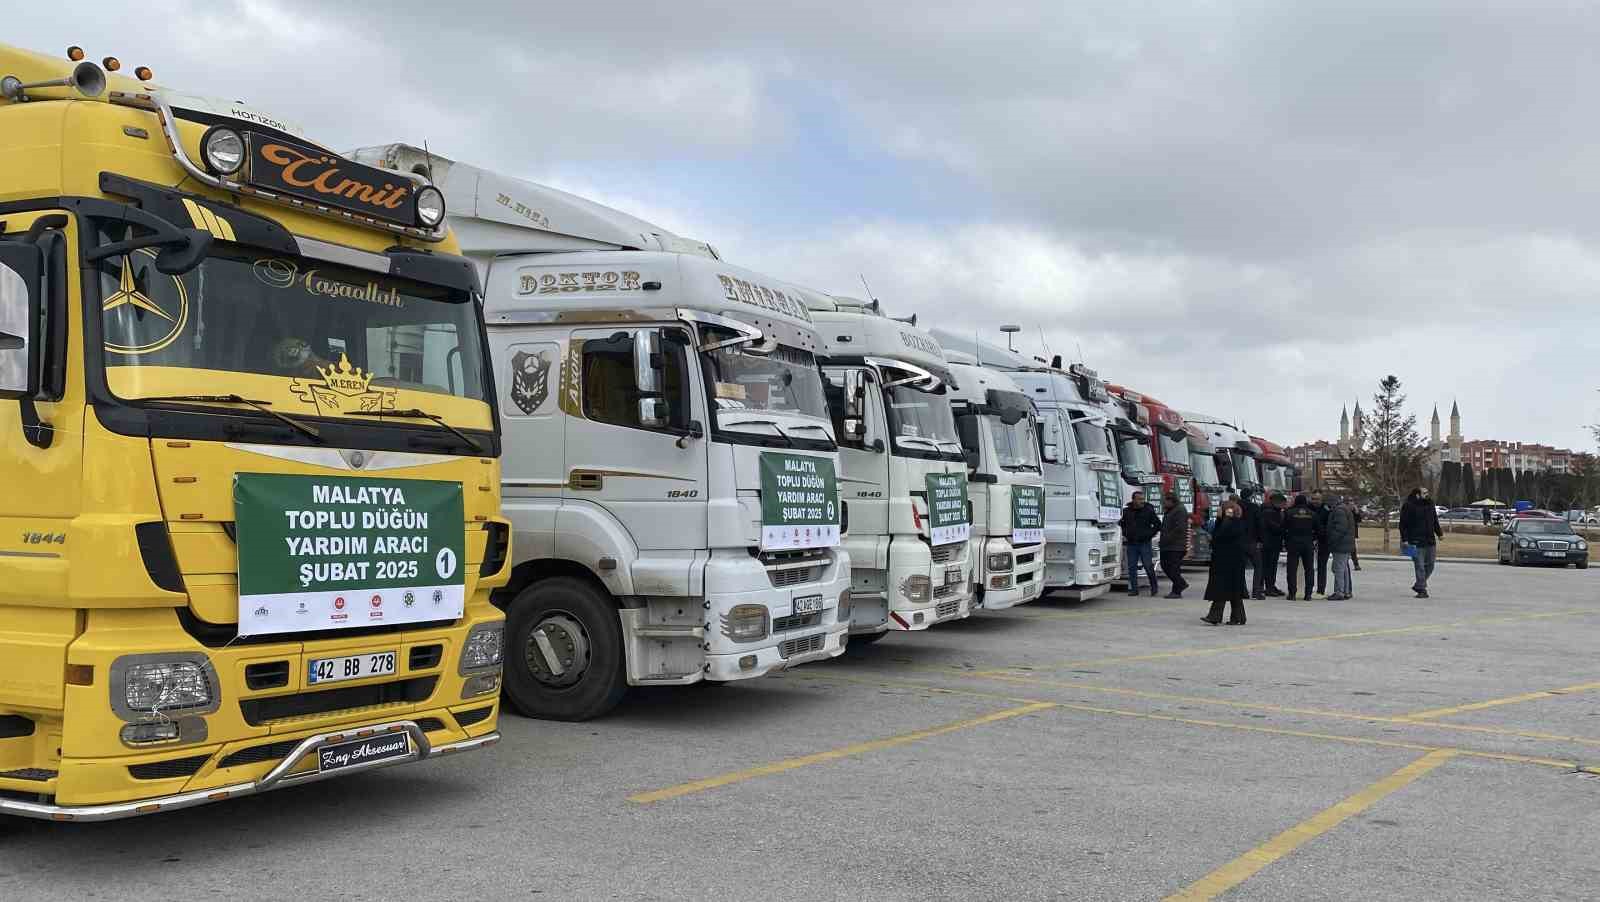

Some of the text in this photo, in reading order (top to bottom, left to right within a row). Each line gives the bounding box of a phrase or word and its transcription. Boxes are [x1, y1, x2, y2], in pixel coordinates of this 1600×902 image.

[784, 460, 816, 473] MALATYA
[777, 474, 825, 488] TOPLU DÜĞÜN
[312, 485, 405, 505] MALATYA
[667, 490, 698, 498] 1840
[777, 491, 825, 503] YARDIM ARACI
[285, 508, 428, 529] TOPLU DÜĞÜN
[783, 508, 822, 522] ŞUBAT 2025
[22, 532, 66, 545] 1844
[285, 536, 428, 556] YARDIM ARACI
[300, 560, 418, 587] ŞUBAT 2025
[317, 654, 394, 679] 42 BB 278
